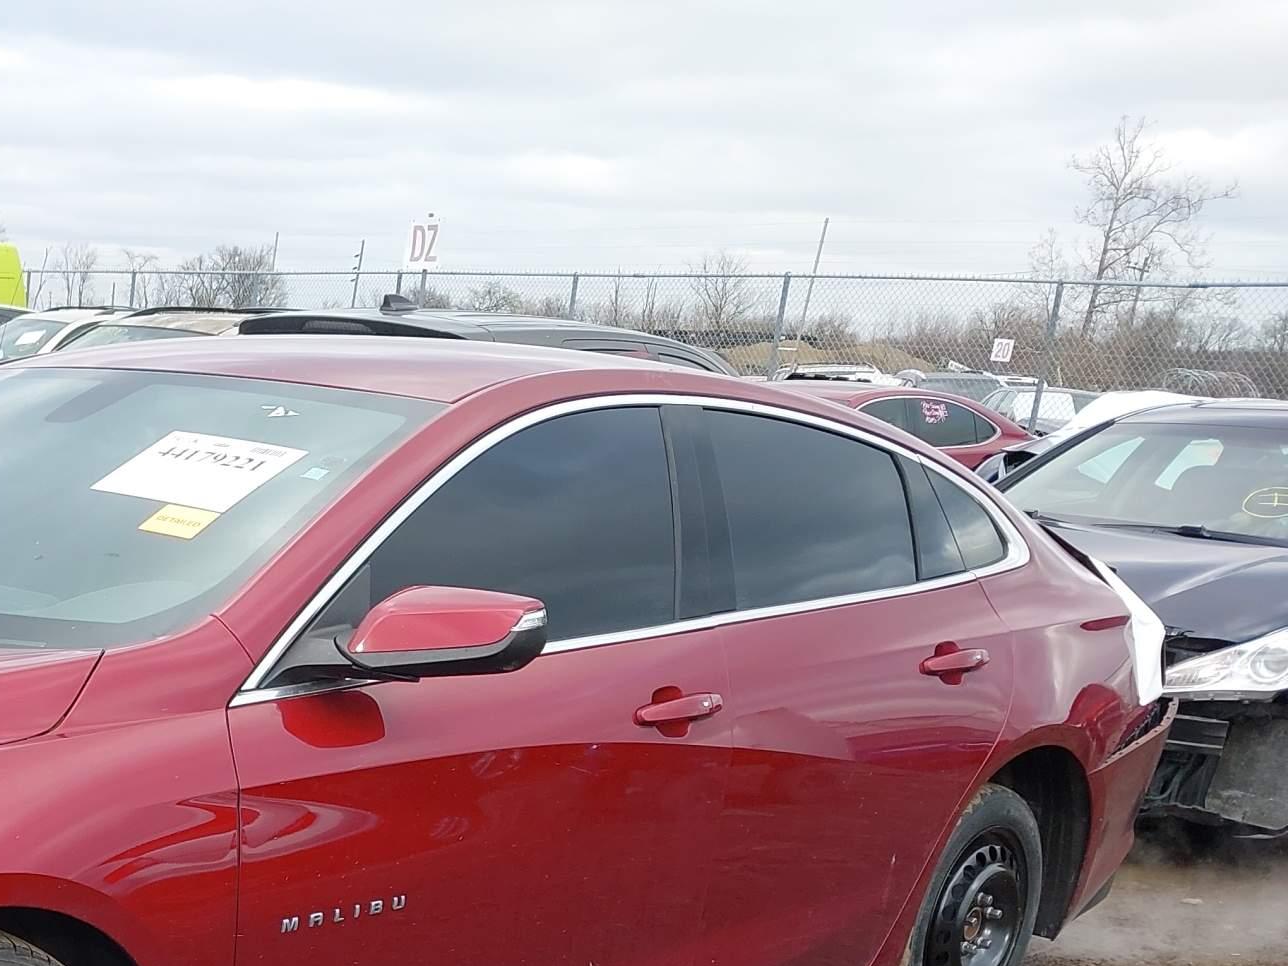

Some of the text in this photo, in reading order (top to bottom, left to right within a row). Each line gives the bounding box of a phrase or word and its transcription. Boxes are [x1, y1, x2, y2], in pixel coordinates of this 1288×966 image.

[409, 224, 439, 262] DZ
[994, 341, 1010, 358] 20
[158, 447, 267, 472] 44179221
[280, 895, 408, 933] MALIBU
